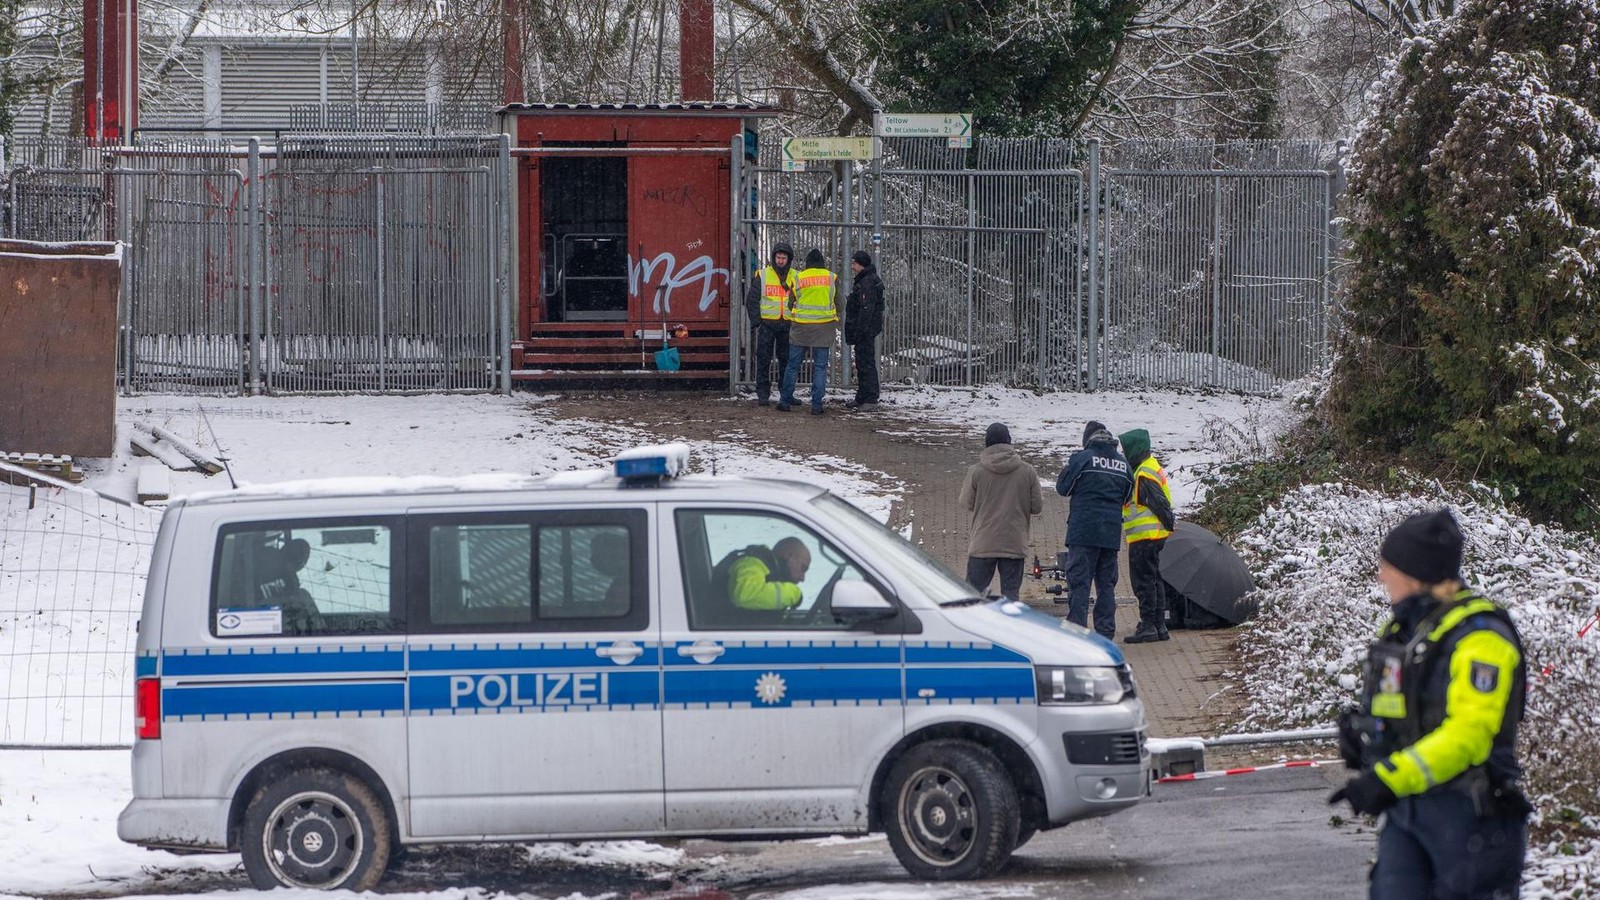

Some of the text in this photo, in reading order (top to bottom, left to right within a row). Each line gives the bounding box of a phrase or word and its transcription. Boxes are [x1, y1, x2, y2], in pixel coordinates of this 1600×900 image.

[885, 116, 909, 124] Teltow
[801, 140, 820, 148] Mitte
[801, 149, 832, 158] Schloßpark
[799, 276, 830, 287] POLIZEI
[1092, 456, 1127, 473] POLIZEI
[450, 673, 609, 708] POLIZEI
